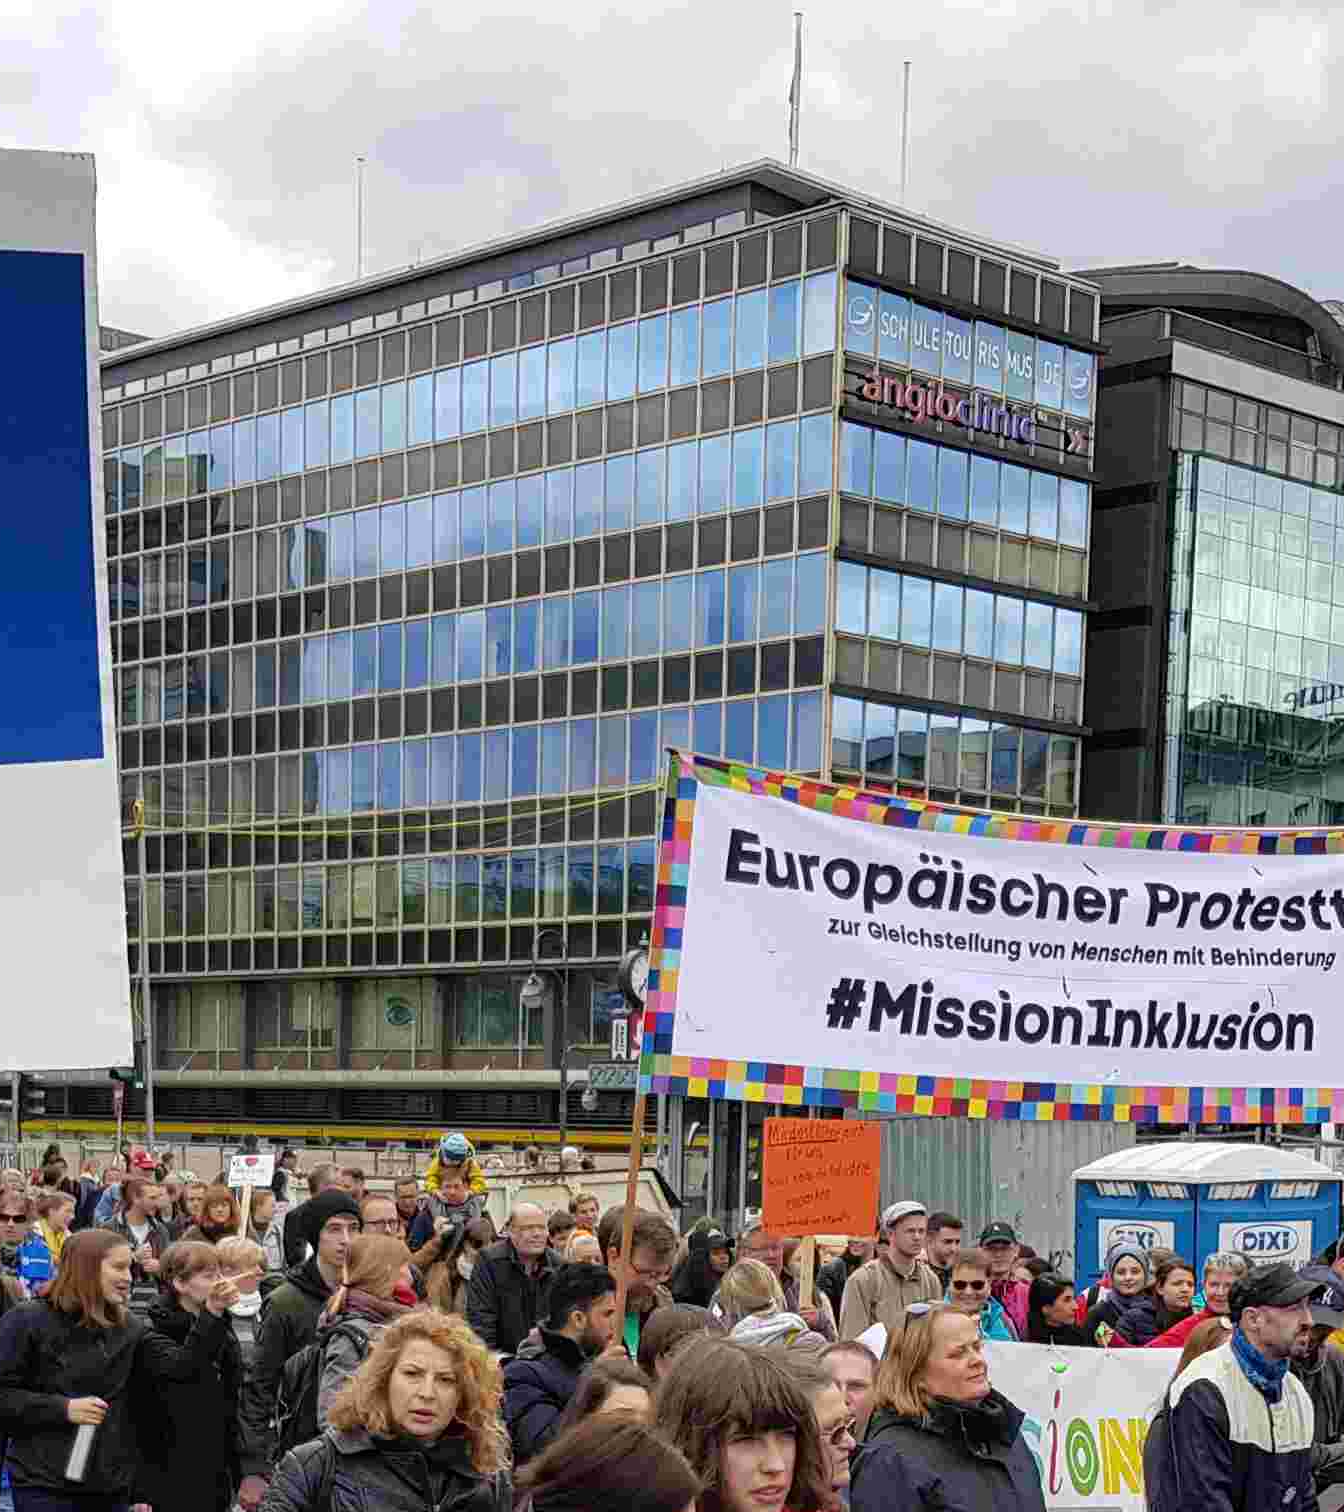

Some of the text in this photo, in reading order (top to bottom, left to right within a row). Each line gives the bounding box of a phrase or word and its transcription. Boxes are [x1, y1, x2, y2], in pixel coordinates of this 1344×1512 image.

[724, 828, 1128, 928] Europäischer
[827, 916, 1336, 971] zur Gleichstellung von Menschen mit Behinderung
[826, 976, 1314, 1052] #MissionInklusion
